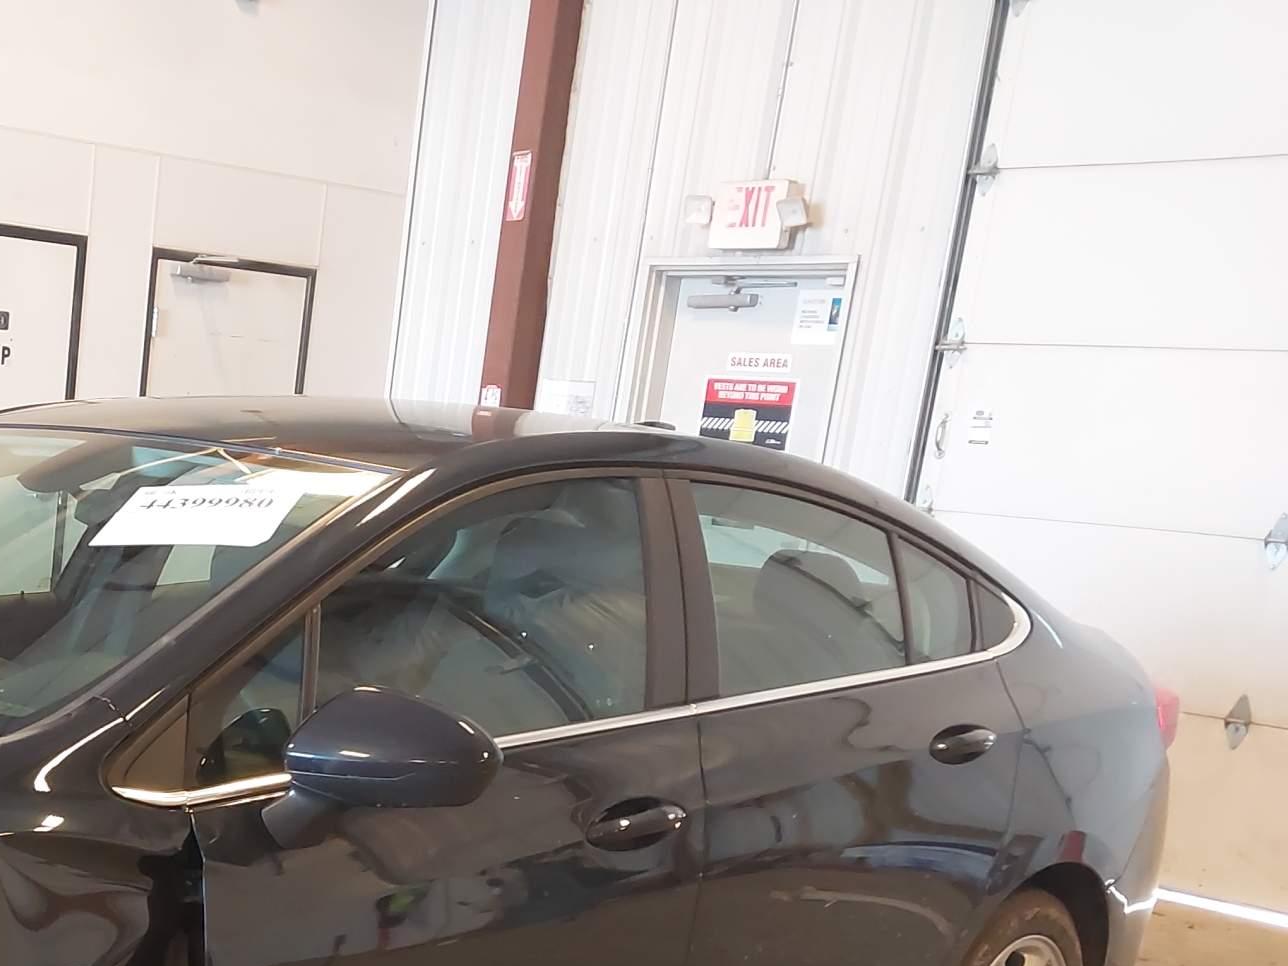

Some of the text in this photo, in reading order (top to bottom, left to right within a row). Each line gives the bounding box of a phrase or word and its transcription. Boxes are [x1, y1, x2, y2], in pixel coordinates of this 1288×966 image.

[728, 186, 776, 228] EXIT
[730, 356, 788, 369] SALES AREA
[139, 496, 275, 510] 44399980
